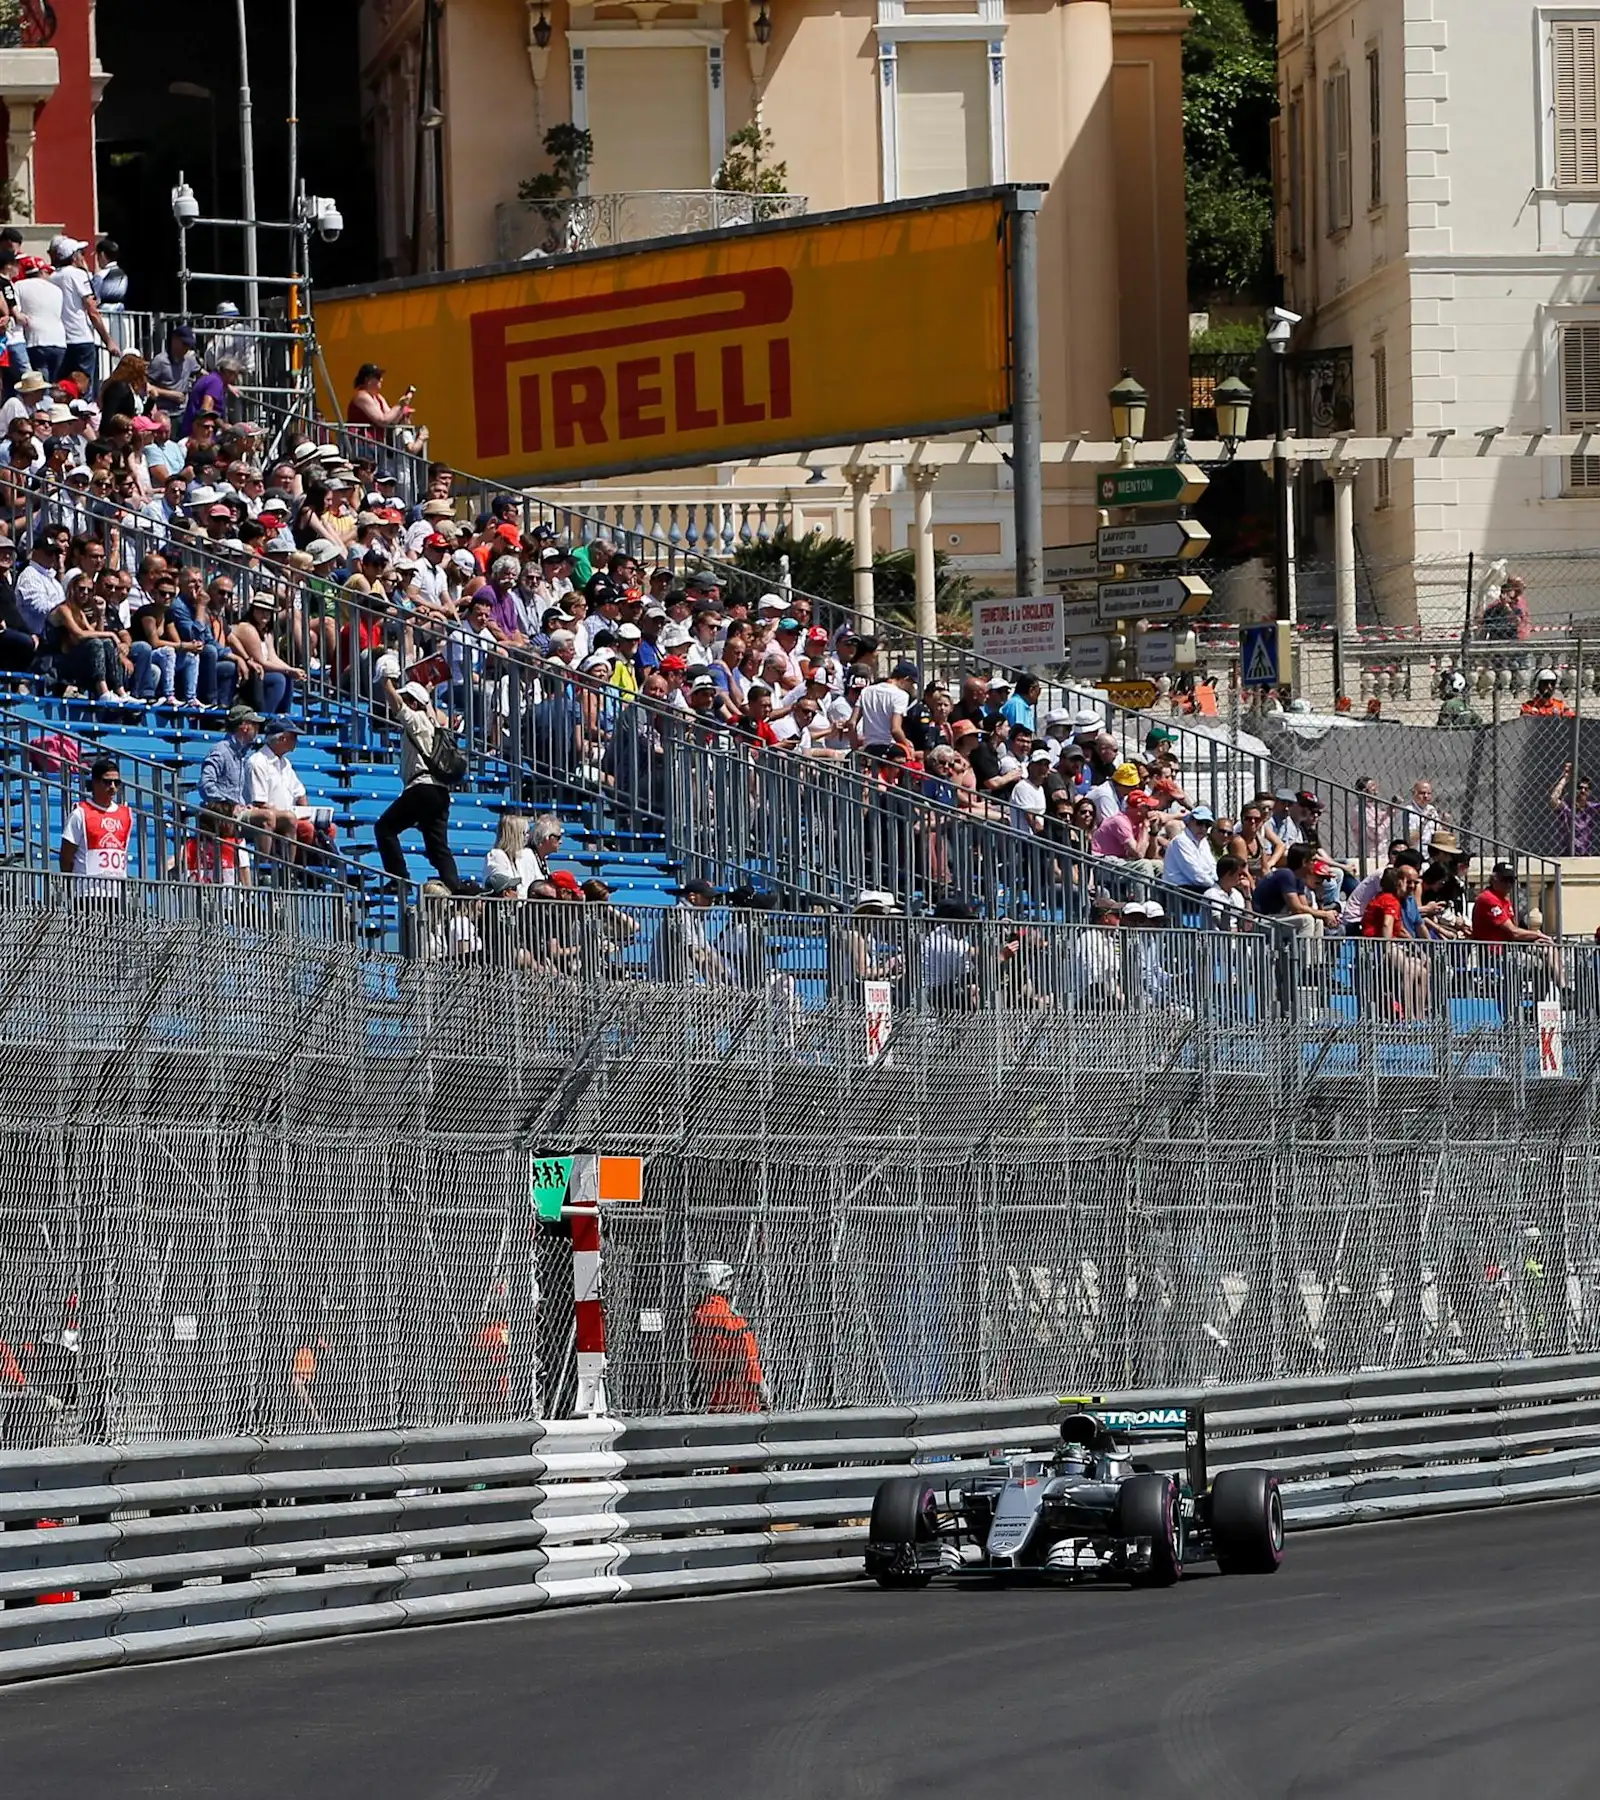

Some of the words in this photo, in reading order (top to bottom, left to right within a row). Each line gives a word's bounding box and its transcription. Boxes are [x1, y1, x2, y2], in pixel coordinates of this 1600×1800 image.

[470, 267, 793, 460] PIRELLI
[1117, 479, 1154, 493] MENTON
[1101, 543, 1148, 556] MONTE-CARLO
[1022, 621, 1056, 633] KENNEDY
[1541, 1026, 1557, 1071] K
